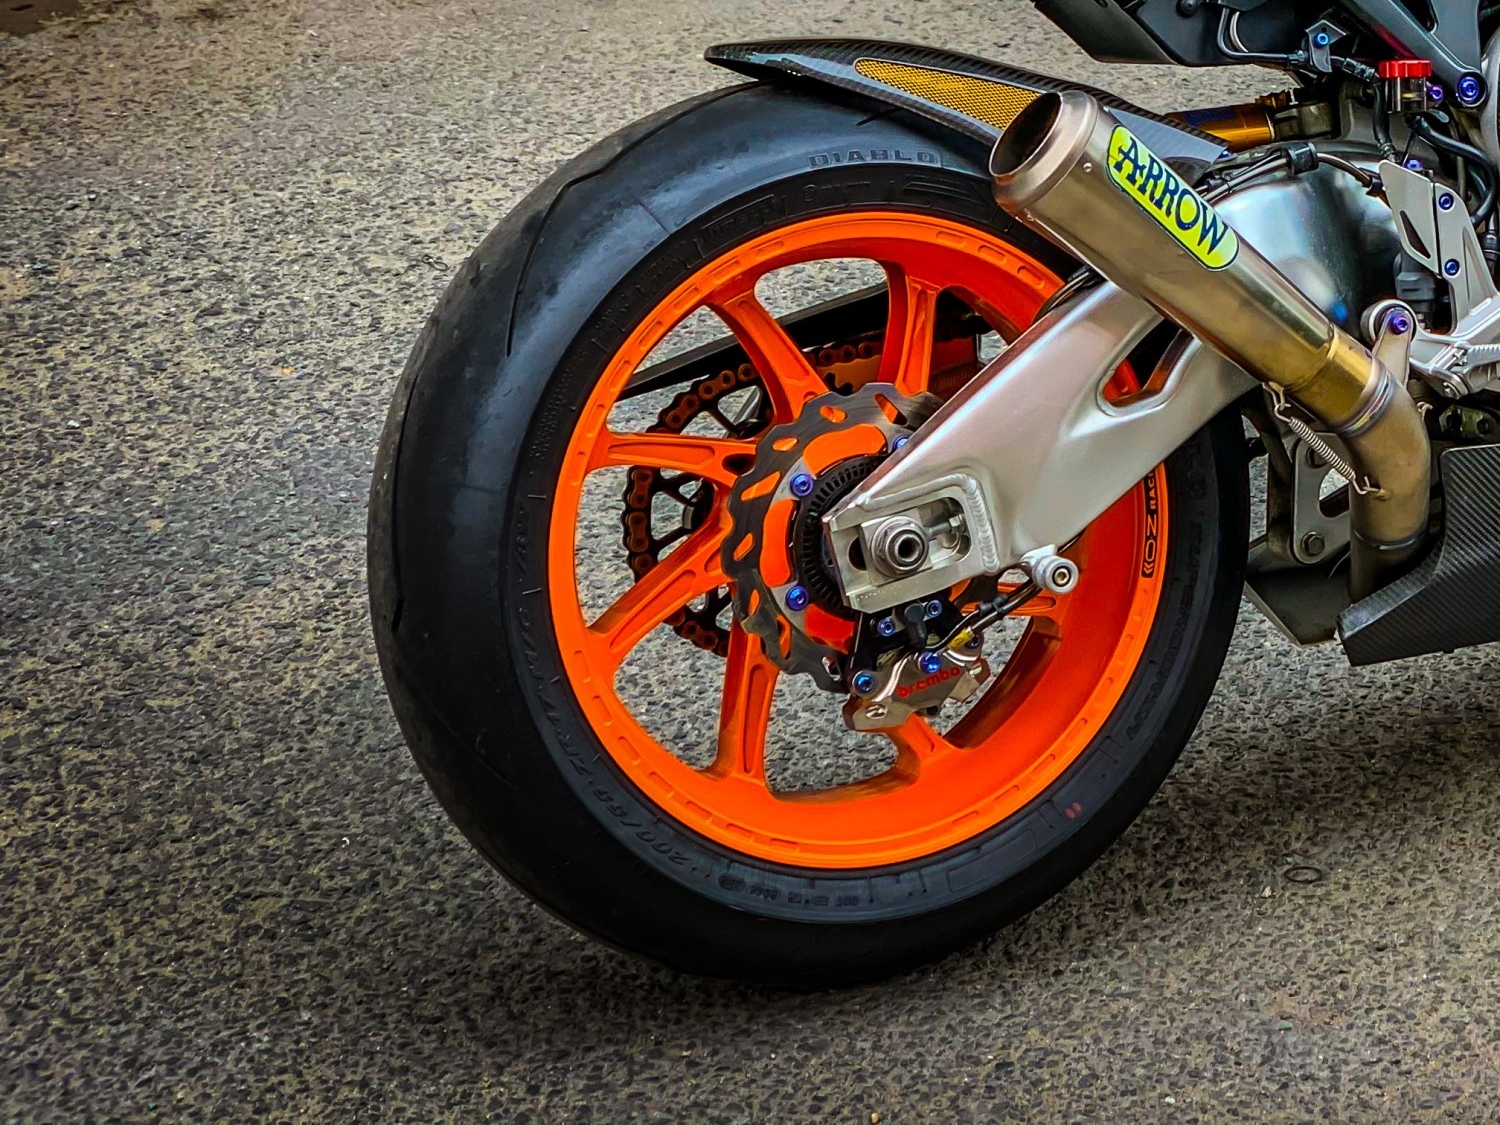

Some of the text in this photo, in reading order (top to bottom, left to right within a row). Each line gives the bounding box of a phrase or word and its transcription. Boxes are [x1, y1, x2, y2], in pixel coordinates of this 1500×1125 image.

[808, 148, 937, 168] DIABLO
[1113, 136, 1229, 256] ARROW
[896, 666, 960, 698] brembo
